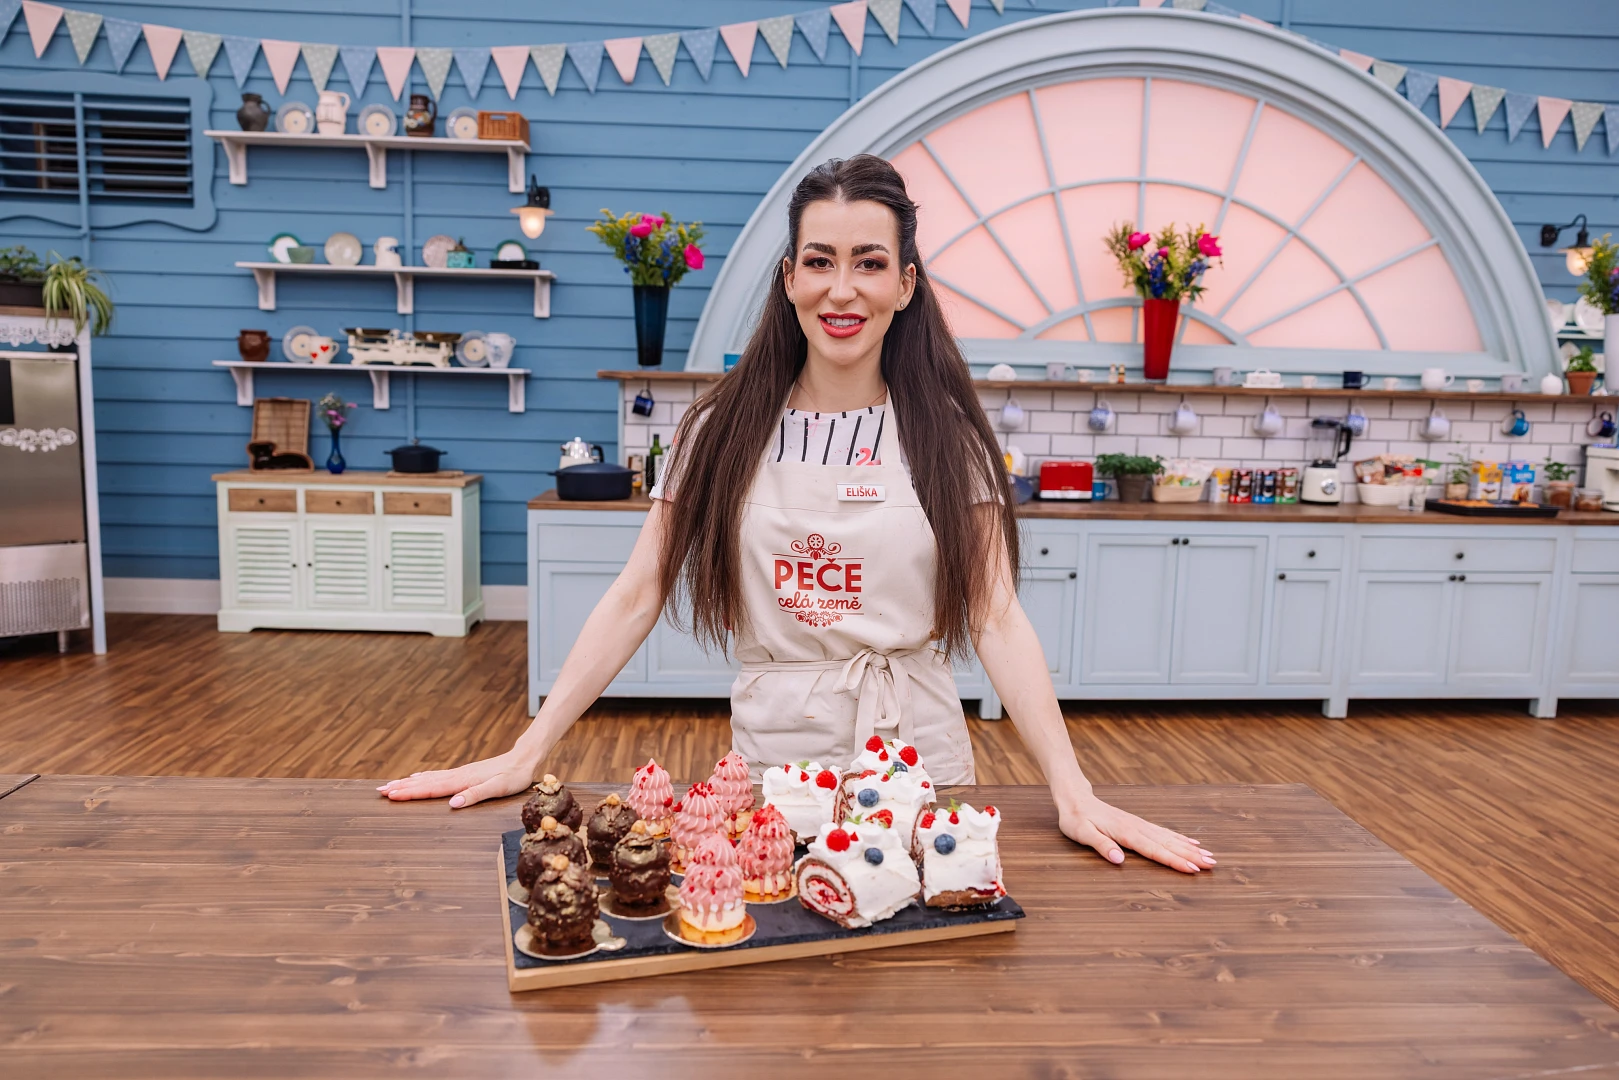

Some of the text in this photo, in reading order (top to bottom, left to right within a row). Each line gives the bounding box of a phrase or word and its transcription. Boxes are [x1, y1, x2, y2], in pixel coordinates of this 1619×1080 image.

[846, 486, 878, 497] ELIŠKA
[775, 558, 862, 593] PEČE
[778, 591, 862, 610] celá země
